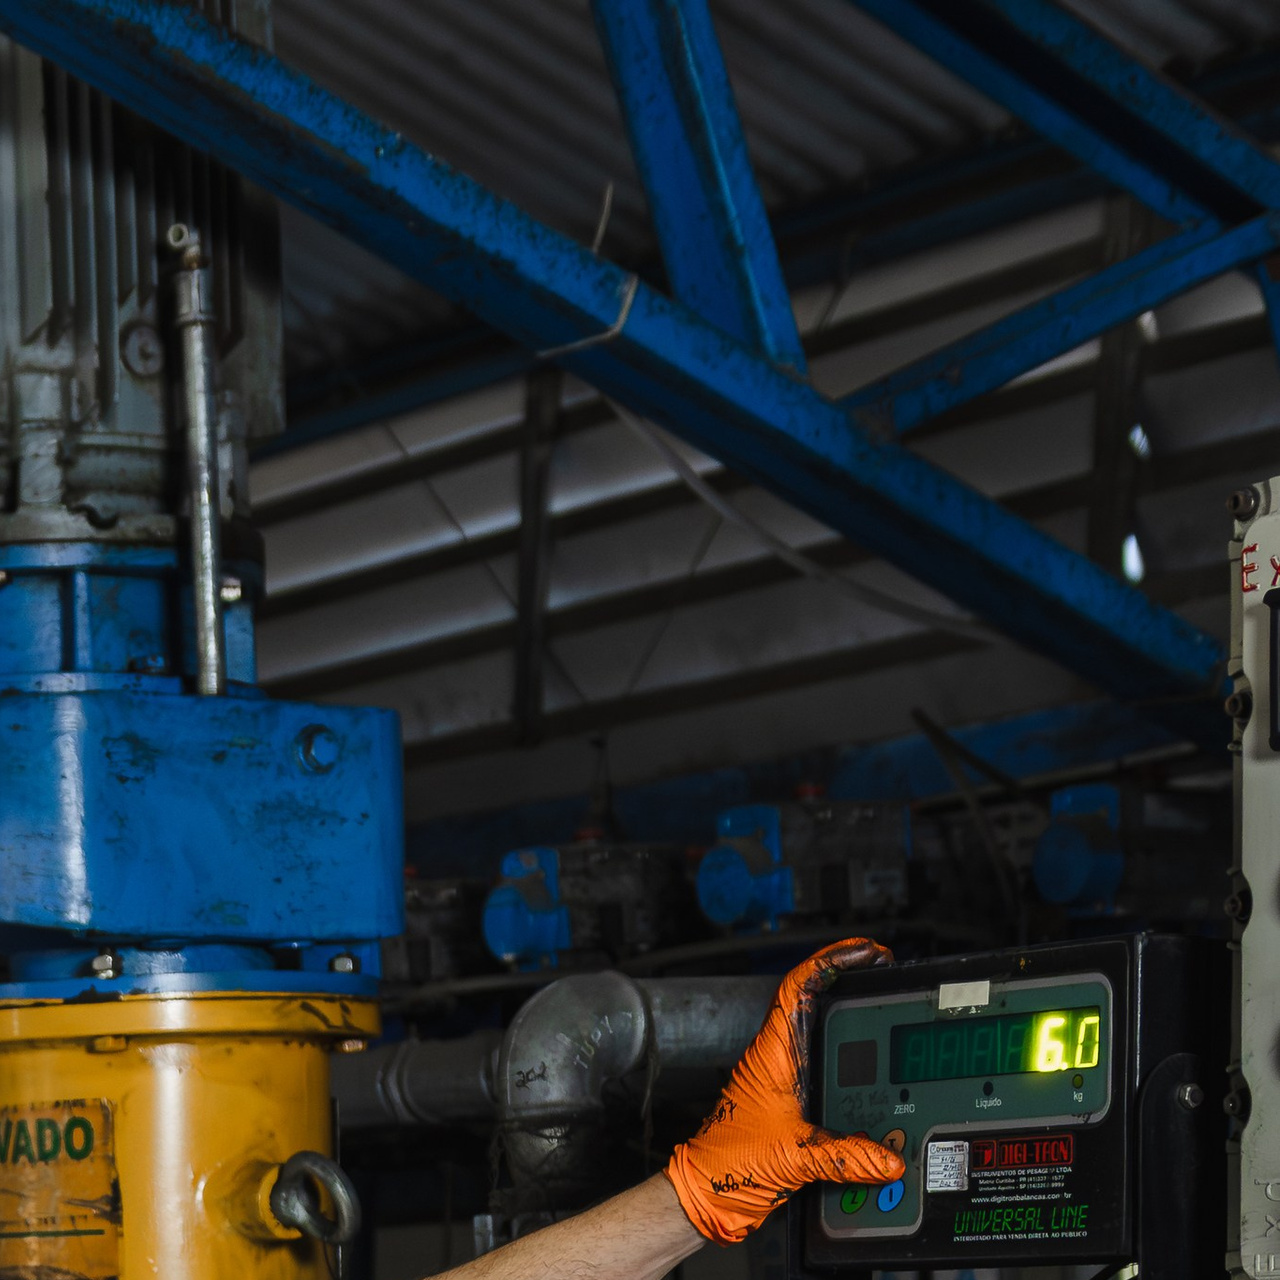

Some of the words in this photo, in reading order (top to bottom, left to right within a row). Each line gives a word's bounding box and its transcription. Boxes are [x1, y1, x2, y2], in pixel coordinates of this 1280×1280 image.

[1037, 1016, 1100, 1072] 6.0
[1073, 1091, 1083, 1102] kg
[894, 1104, 916, 1114] ZERO
[851, 1190, 859, 1205] Z
[954, 1207, 1045, 1234] UNIVERSAL
[1051, 1204, 1089, 1230] LINE
